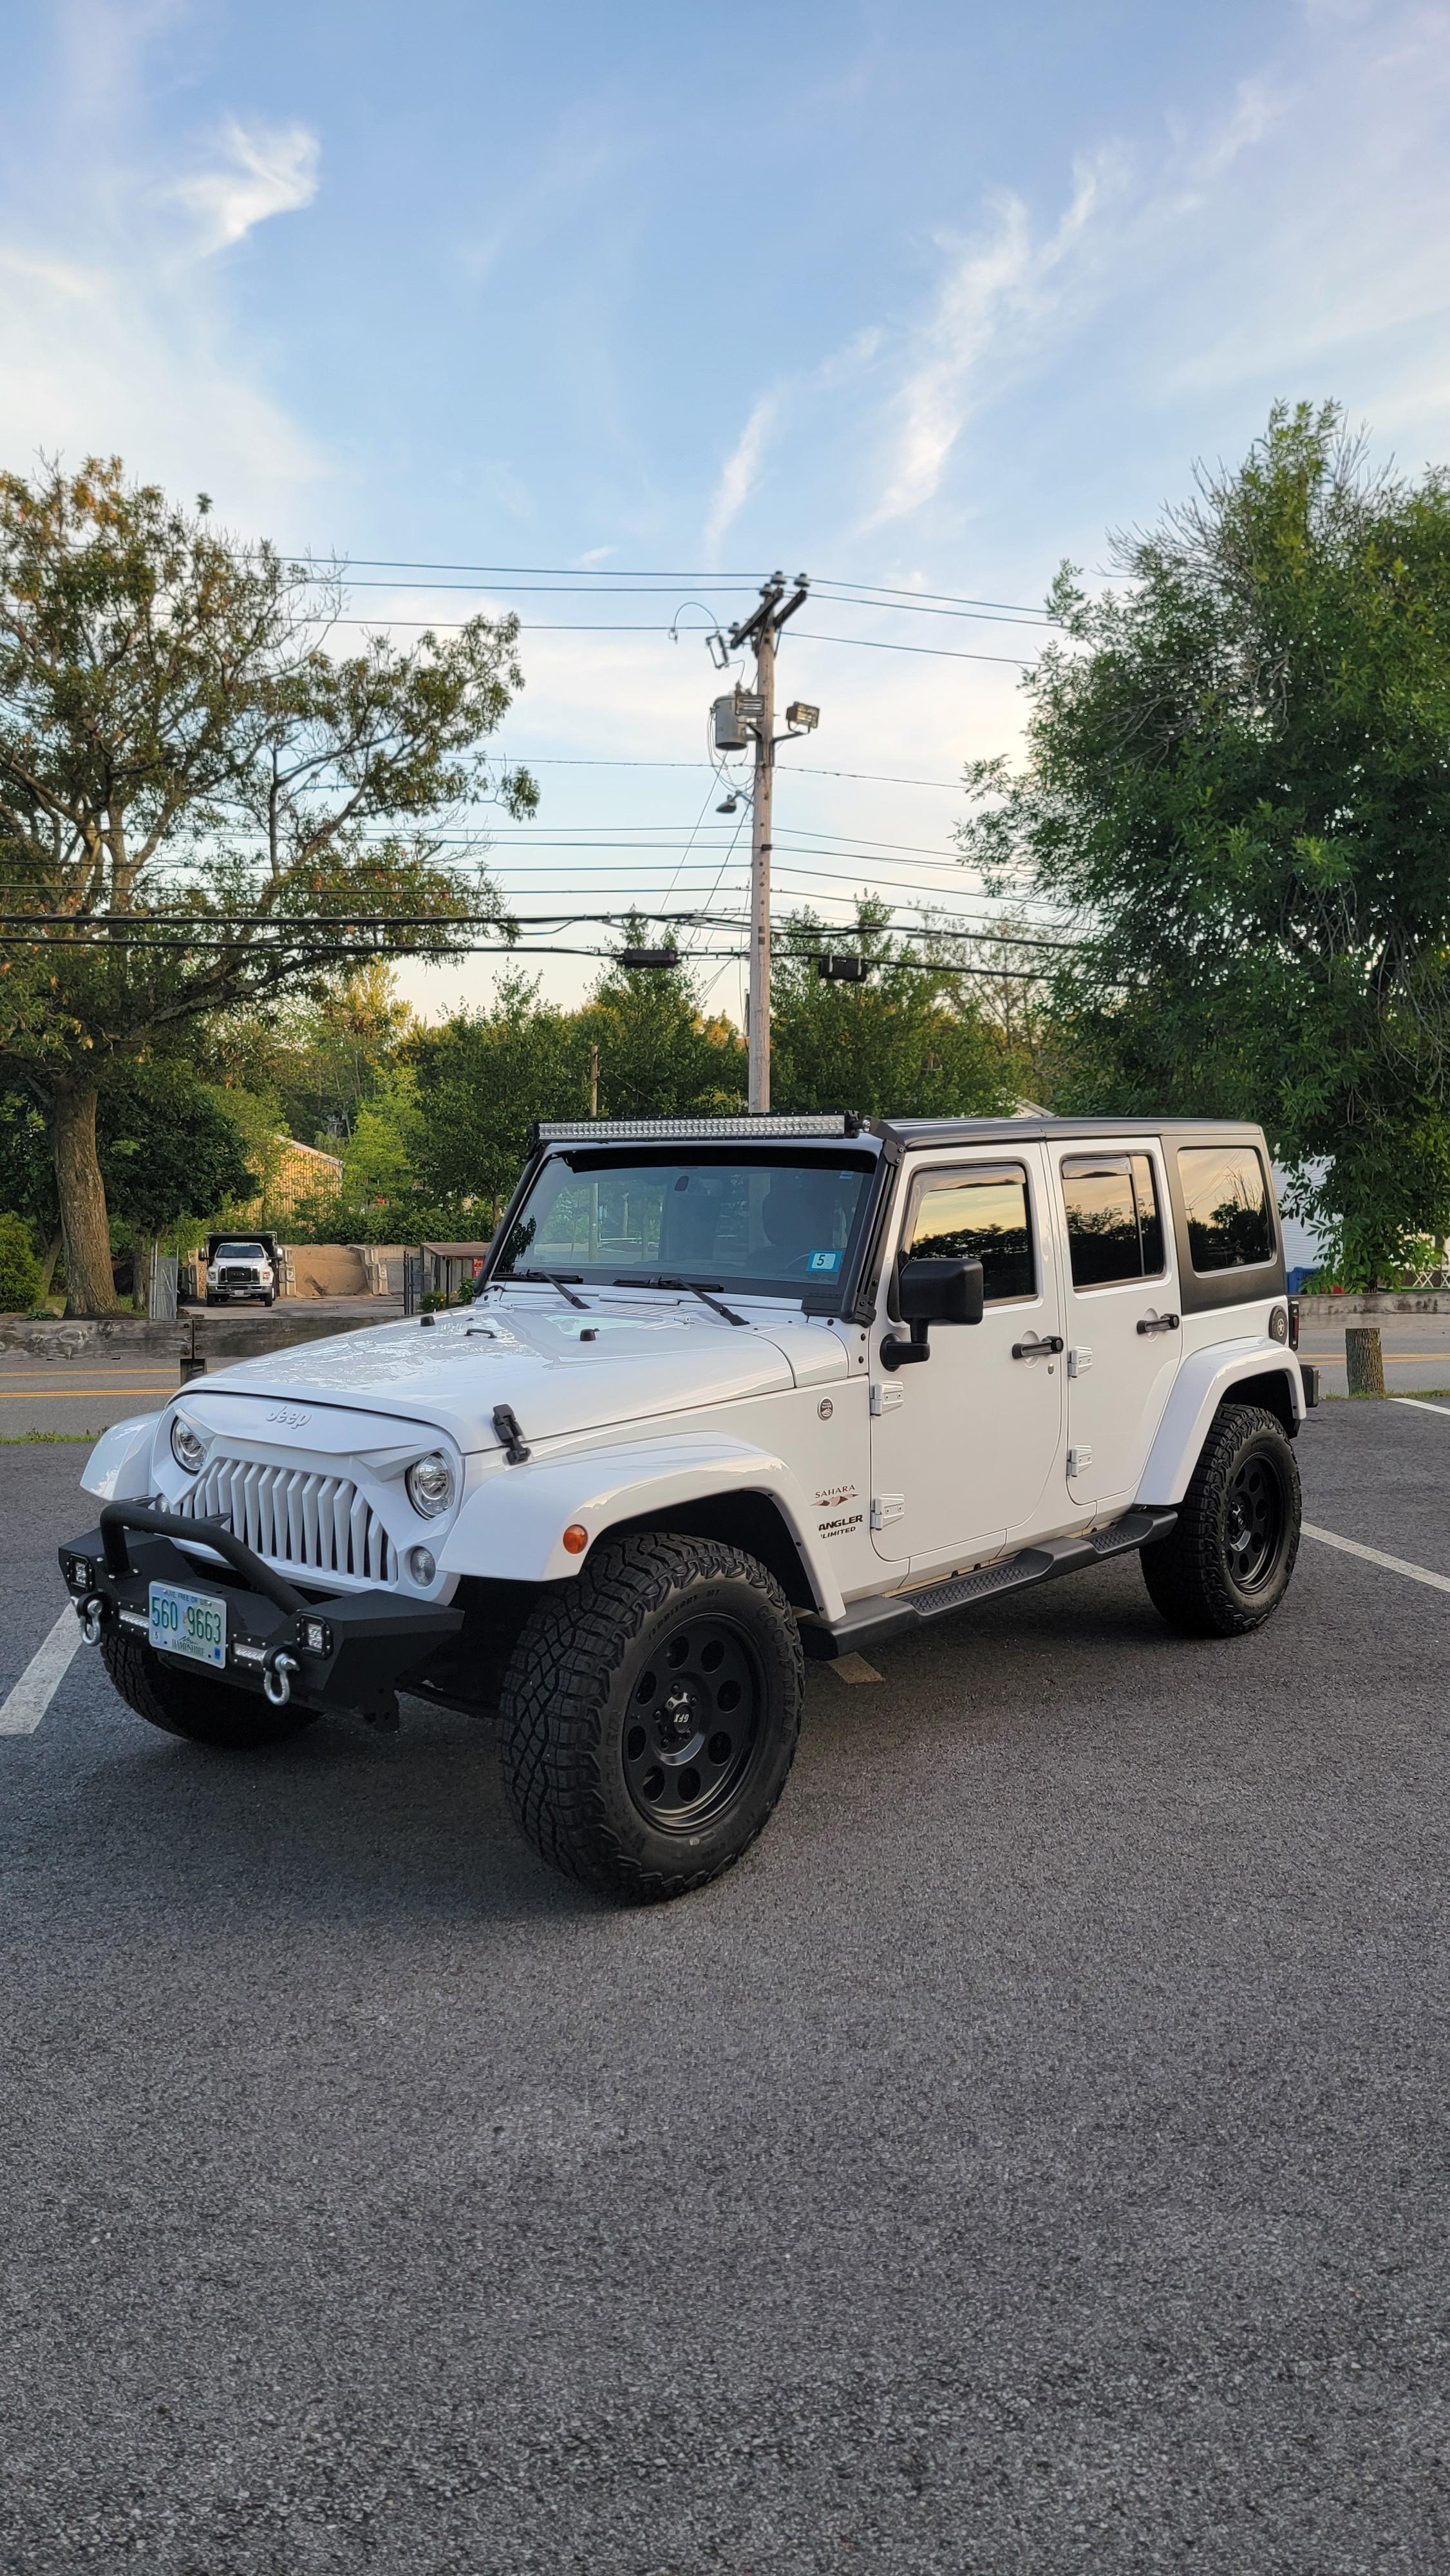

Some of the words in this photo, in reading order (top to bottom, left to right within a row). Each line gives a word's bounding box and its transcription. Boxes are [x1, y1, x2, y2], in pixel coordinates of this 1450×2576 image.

[816, 1254, 825, 1266] 5
[265, 1406, 312, 1430] Jeep
[814, 1484, 855, 1498] SAHARA
[817, 1515, 863, 1531] ANGLER
[821, 1526, 856, 1539] LIMITED
[178, 1593, 189, 1602] FREE
[151, 1596, 178, 1631] 560
[187, 1605, 221, 1645] 9663
[172, 1639, 205, 1656] HAMPSHIRE
[758, 1604, 796, 1743] GOODYEAR
[673, 1714, 690, 1723] GFX
